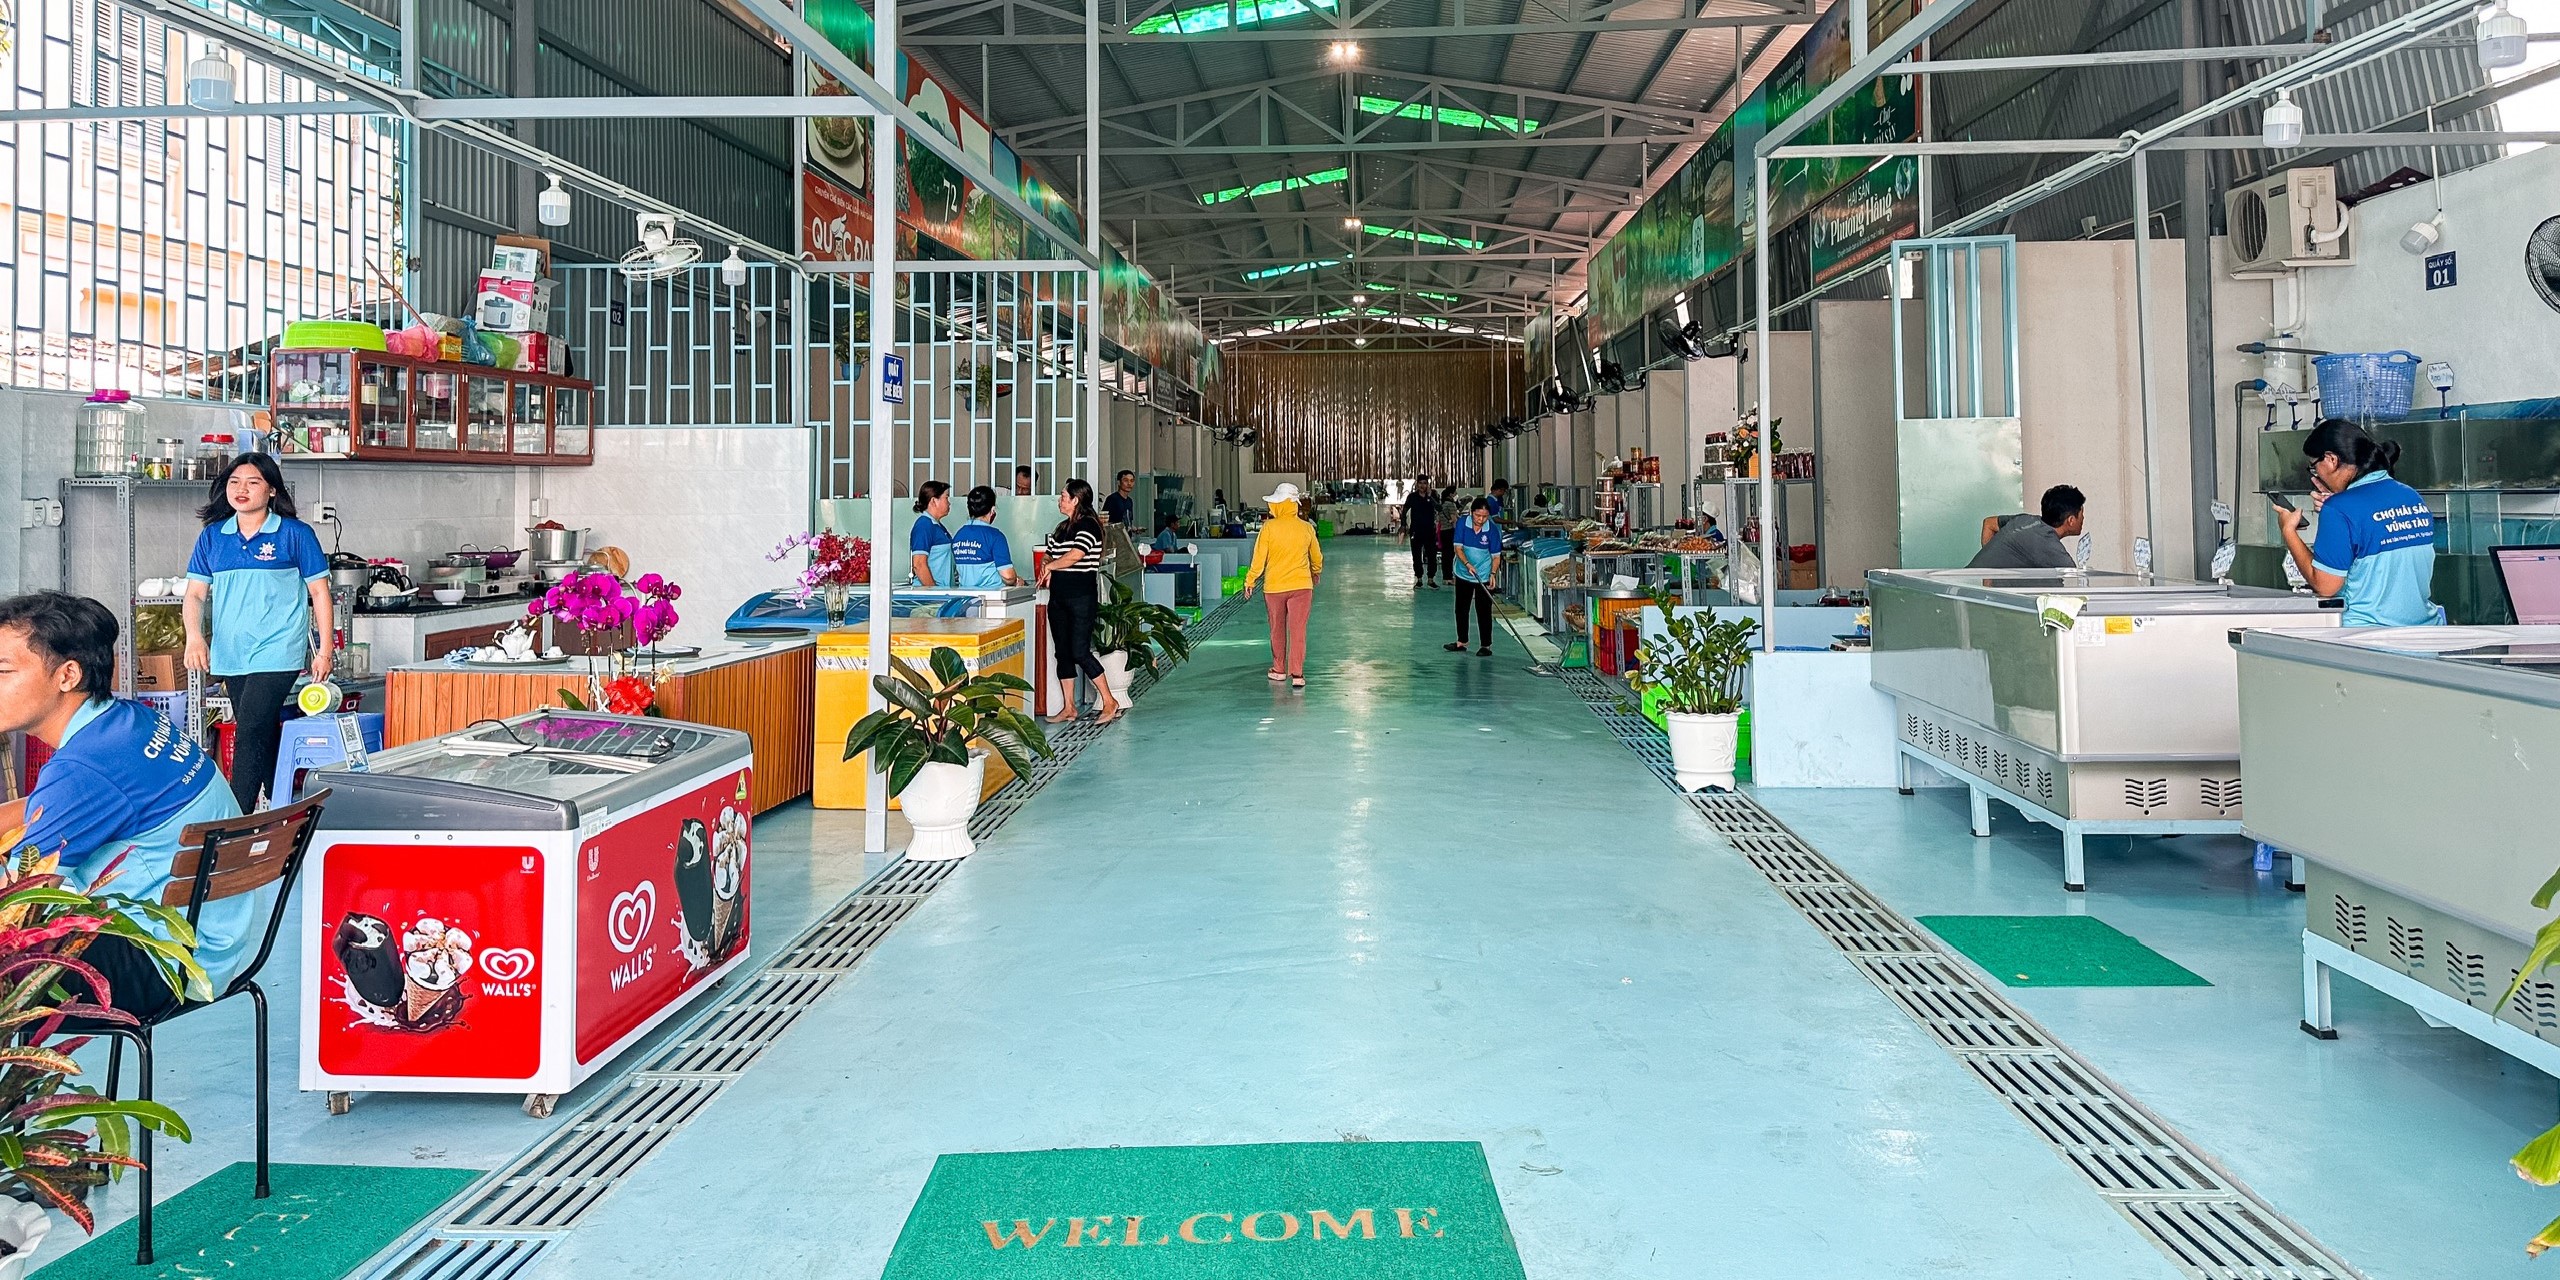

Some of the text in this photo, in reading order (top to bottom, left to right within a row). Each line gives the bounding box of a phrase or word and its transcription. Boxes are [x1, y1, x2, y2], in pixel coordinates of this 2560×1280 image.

[2433, 268, 2450, 286] 01
[612, 310, 622, 324] 02
[2372, 508, 2395, 521] CHỢ
[2395, 505, 2412, 517] HẢI
[2385, 517, 2429, 533] VŨNG TÀU
[144, 730, 171, 759] CHỢ
[610, 946, 653, 994] WALL'S
[481, 982, 532, 997] WALL'S
[980, 1206, 1446, 1251] WELCOME
